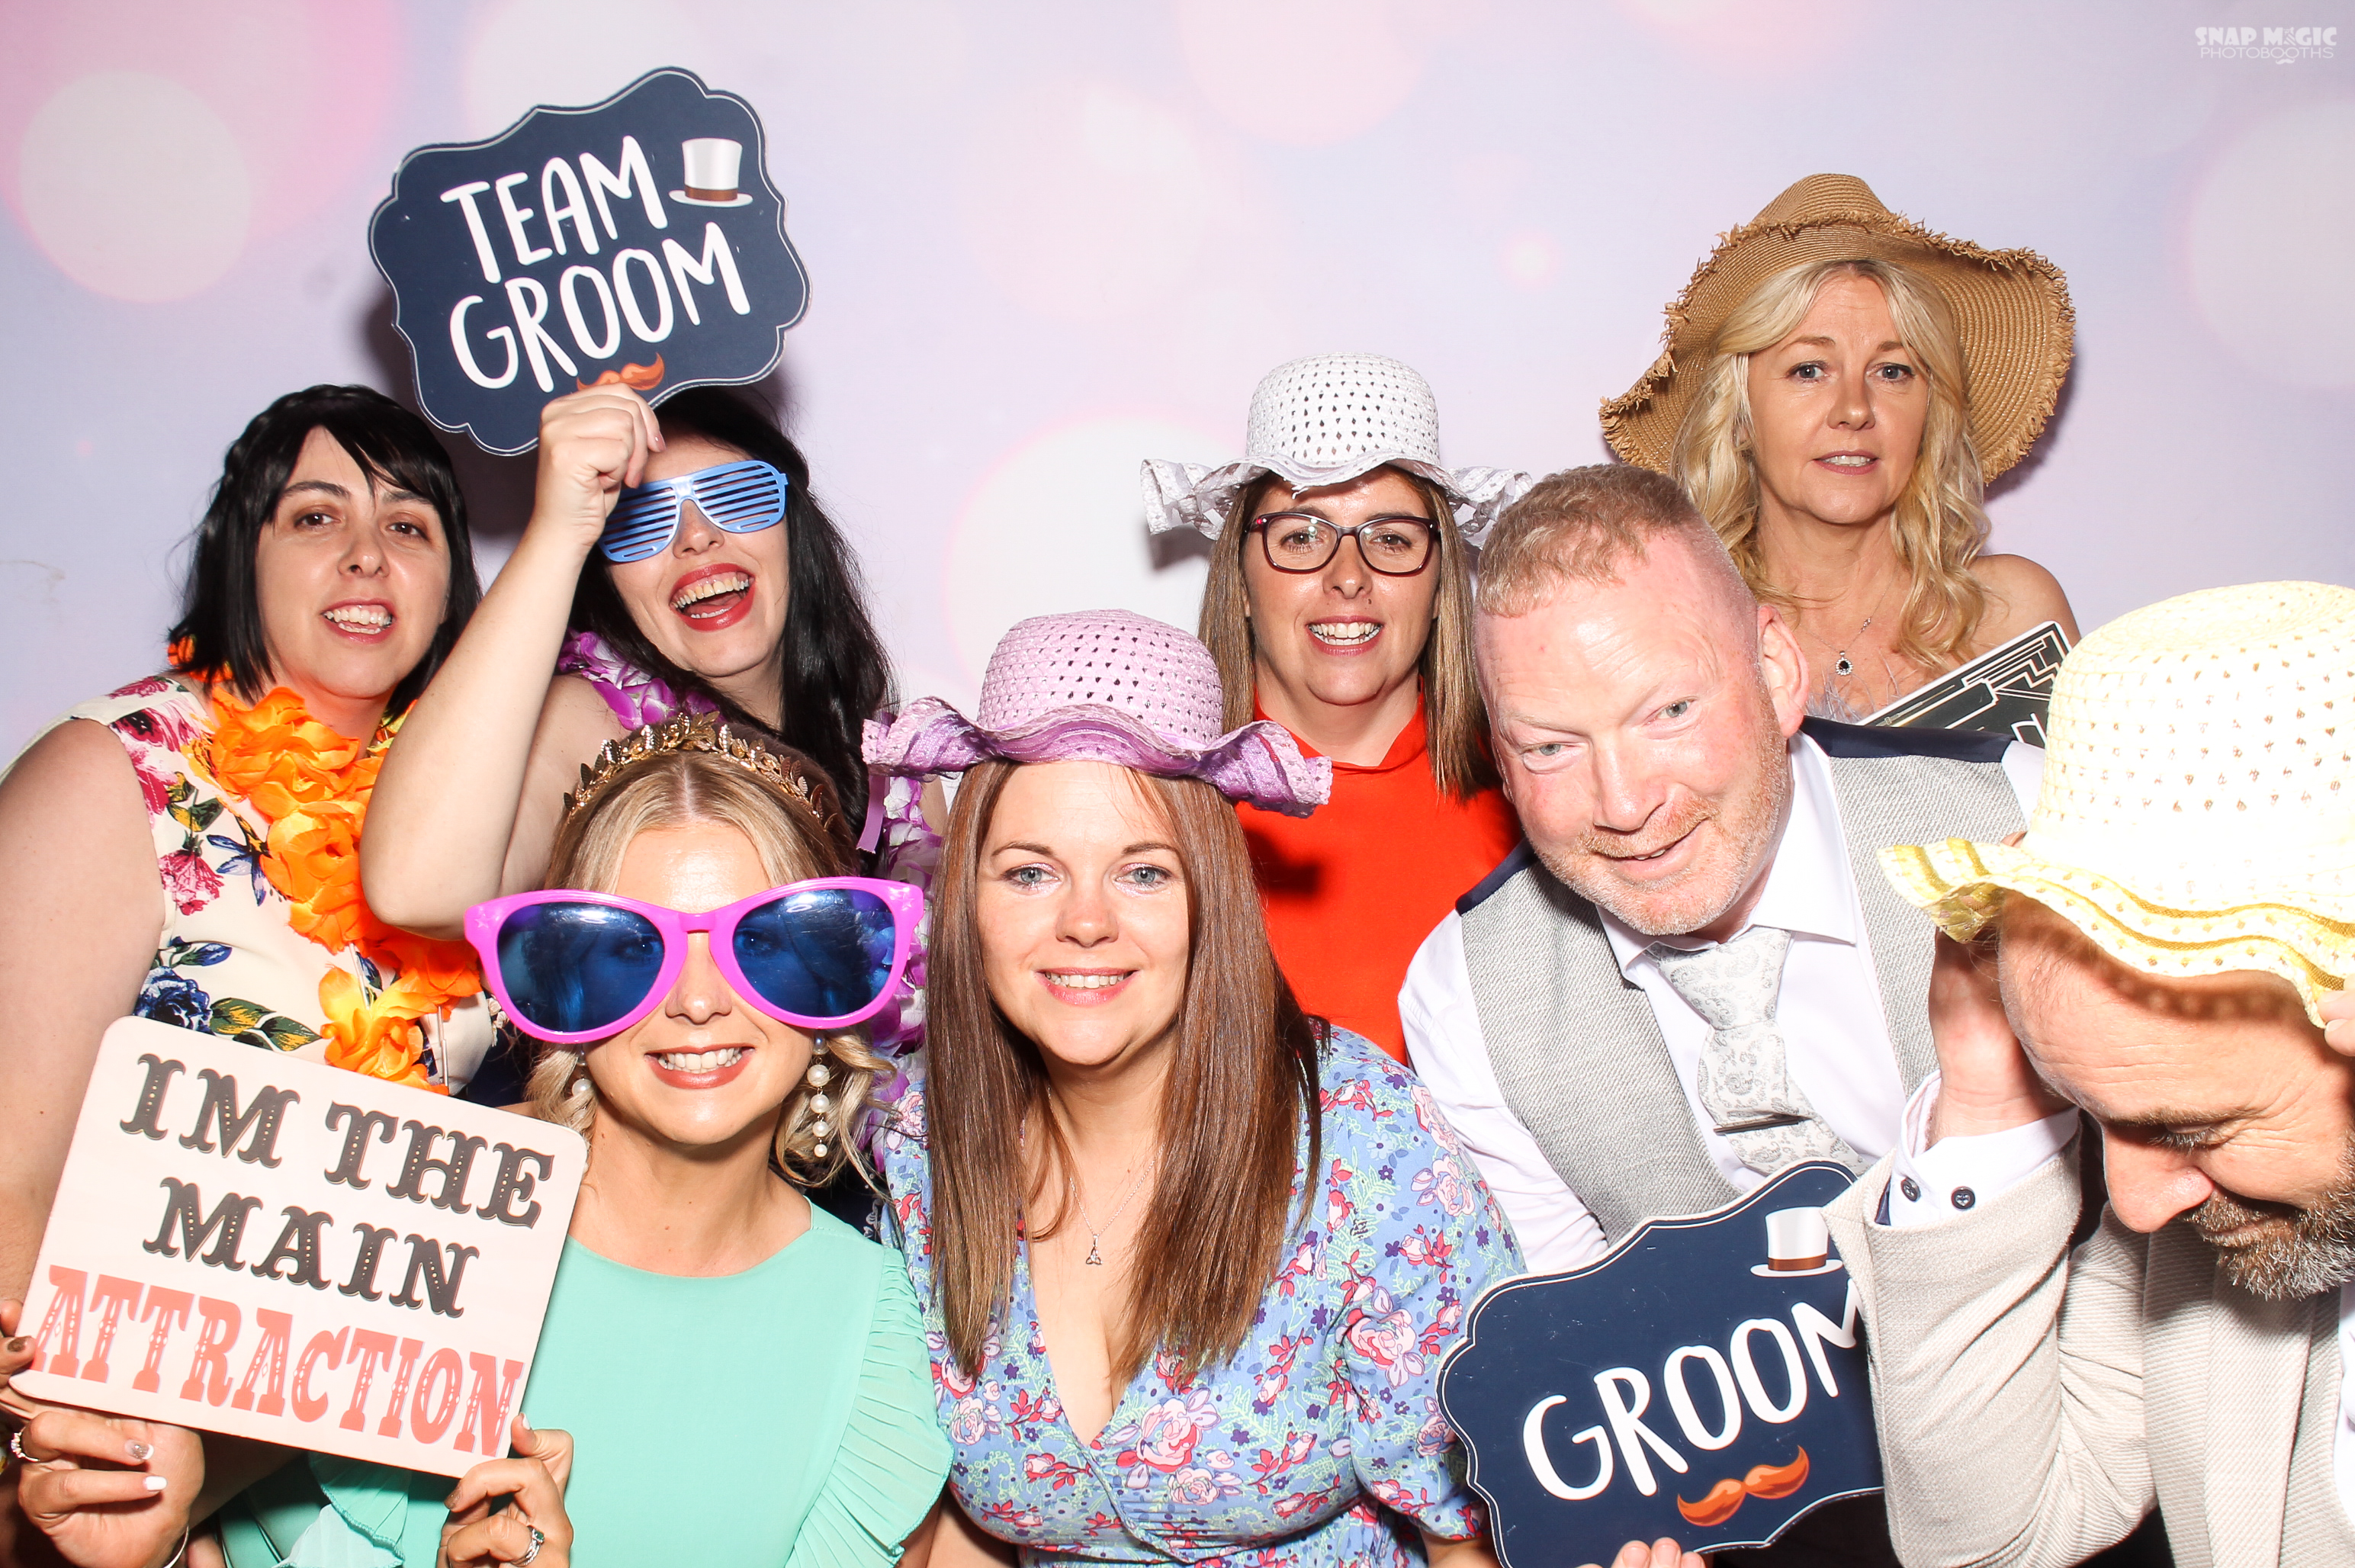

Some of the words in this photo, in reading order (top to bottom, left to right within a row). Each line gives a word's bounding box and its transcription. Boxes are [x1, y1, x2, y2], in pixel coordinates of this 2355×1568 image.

[440, 135, 668, 284] TEAM
[449, 221, 751, 393] GROOM
[119, 1052, 300, 1169] IM
[324, 1100, 556, 1229] THE
[142, 1177, 480, 1318] MAIN
[32, 1264, 525, 1457] ATTRACTION
